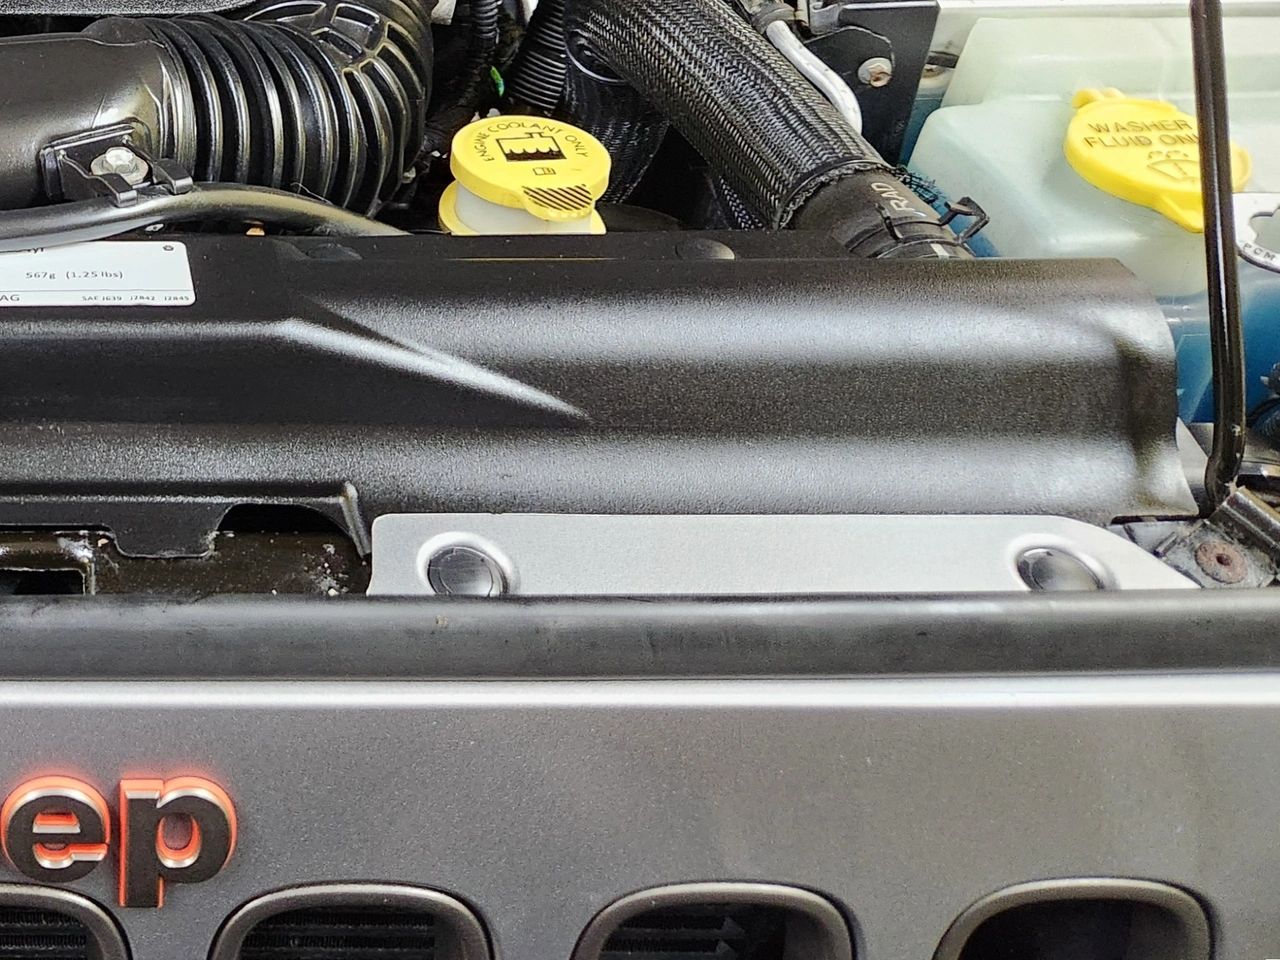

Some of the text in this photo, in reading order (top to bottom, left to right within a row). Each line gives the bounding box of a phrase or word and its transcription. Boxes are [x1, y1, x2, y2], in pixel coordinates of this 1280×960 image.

[1088, 120, 1193, 134] WASHER
[472, 121, 590, 162] ENGINE COOLANT ONLY
[1084, 134, 1152, 148] FLUID
[870, 182, 915, 212] RAD
[1243, 242, 1276, 261] PCM
[26, 271, 123, 280] 567g (1.25 lbs)
